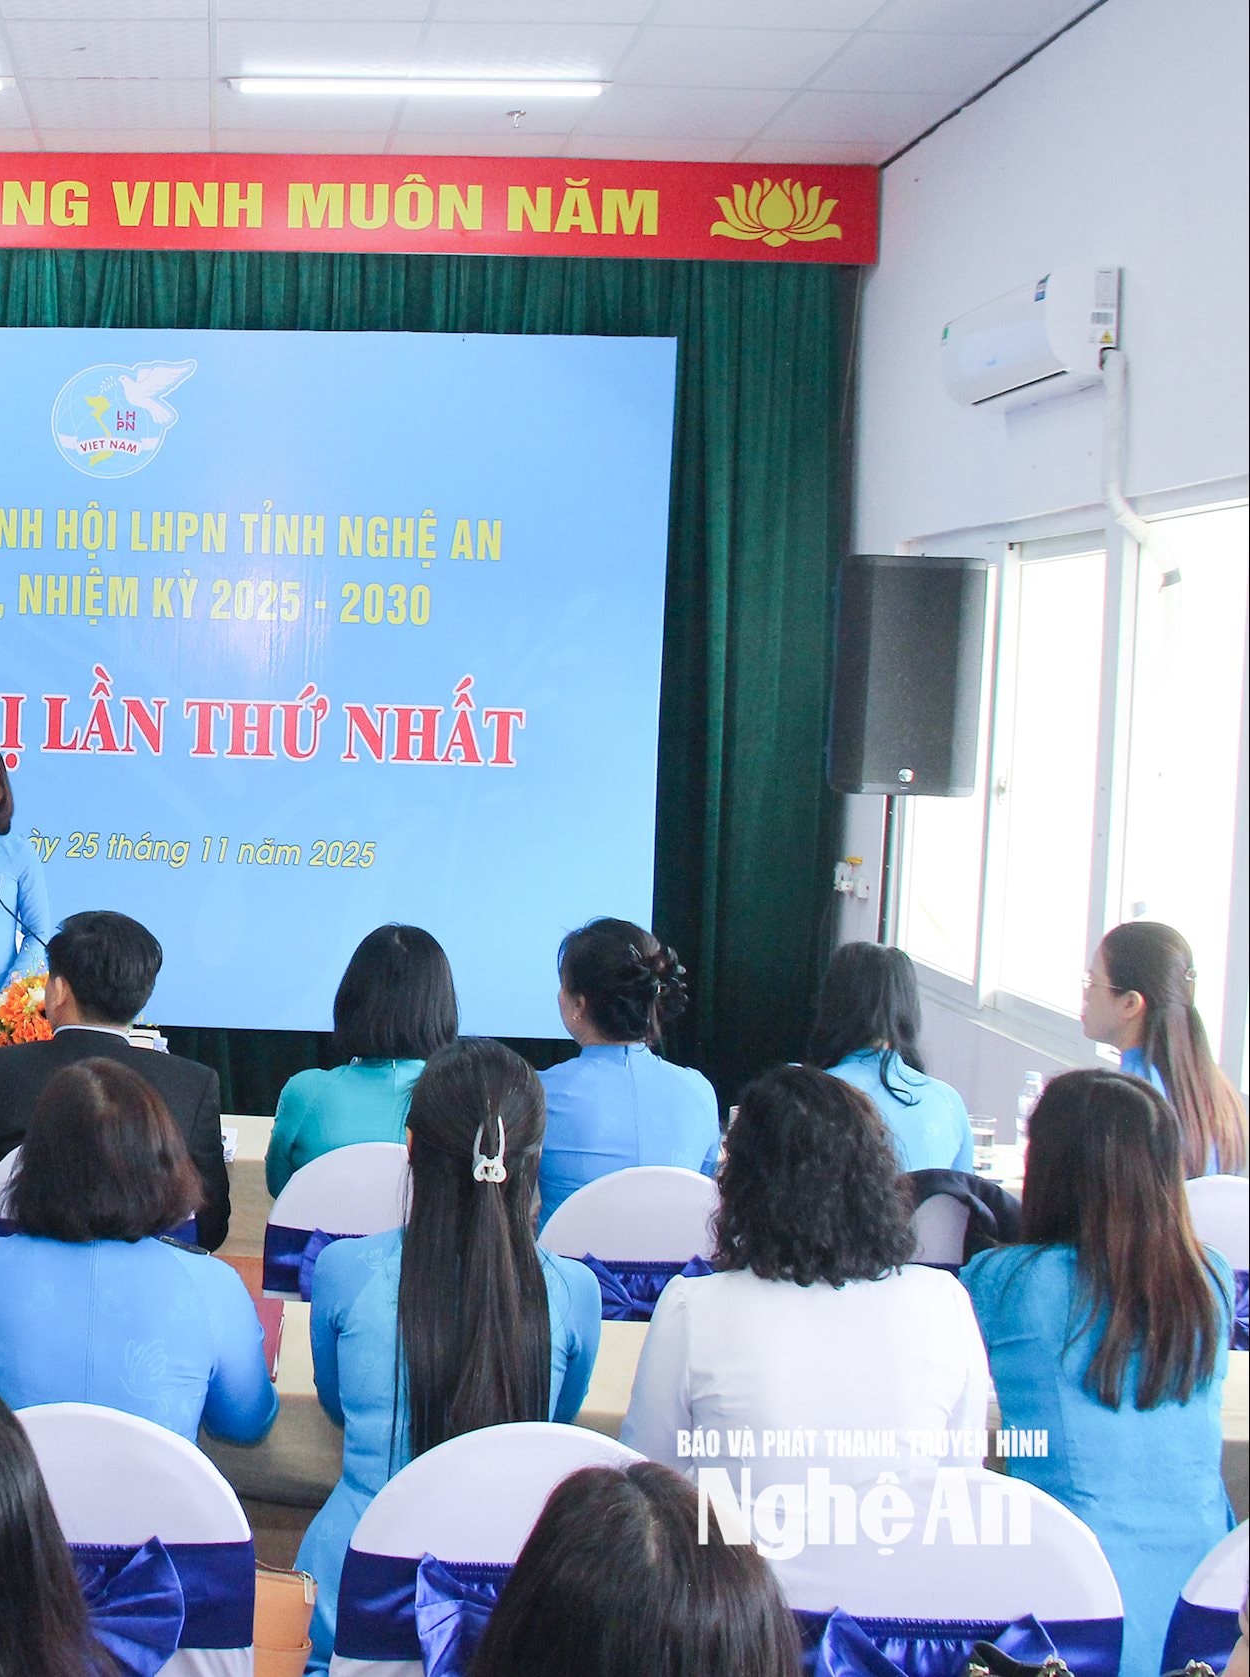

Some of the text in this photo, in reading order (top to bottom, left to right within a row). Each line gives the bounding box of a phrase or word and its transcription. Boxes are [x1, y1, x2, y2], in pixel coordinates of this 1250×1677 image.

[111, 181, 264, 228] VINH
[287, 173, 484, 231] MUÔN
[507, 176, 659, 236] NĂM
[80, 440, 137, 453] VIET NAM
[116, 420, 136, 431] PN
[57, 501, 118, 560] HỘI
[131, 511, 227, 553] LHPN
[240, 499, 325, 556] TỈNH
[338, 508, 438, 569] NGHỆ
[451, 519, 503, 561] AN
[18, 567, 139, 626] NHIỆM
[153, 569, 198, 620] KỲ
[211, 579, 300, 622] 2025
[315, 601, 327, 609] -
[340, 584, 431, 626] 2030
[44, 665, 166, 754] LẦN
[185, 684, 329, 760] THỨ
[343, 676, 524, 766] NHẤT
[65, 831, 100, 859] 25
[106, 831, 191, 869] tháng
[201, 836, 229, 863] 11
[237, 838, 302, 866] năm
[308, 840, 377, 868] 2025
